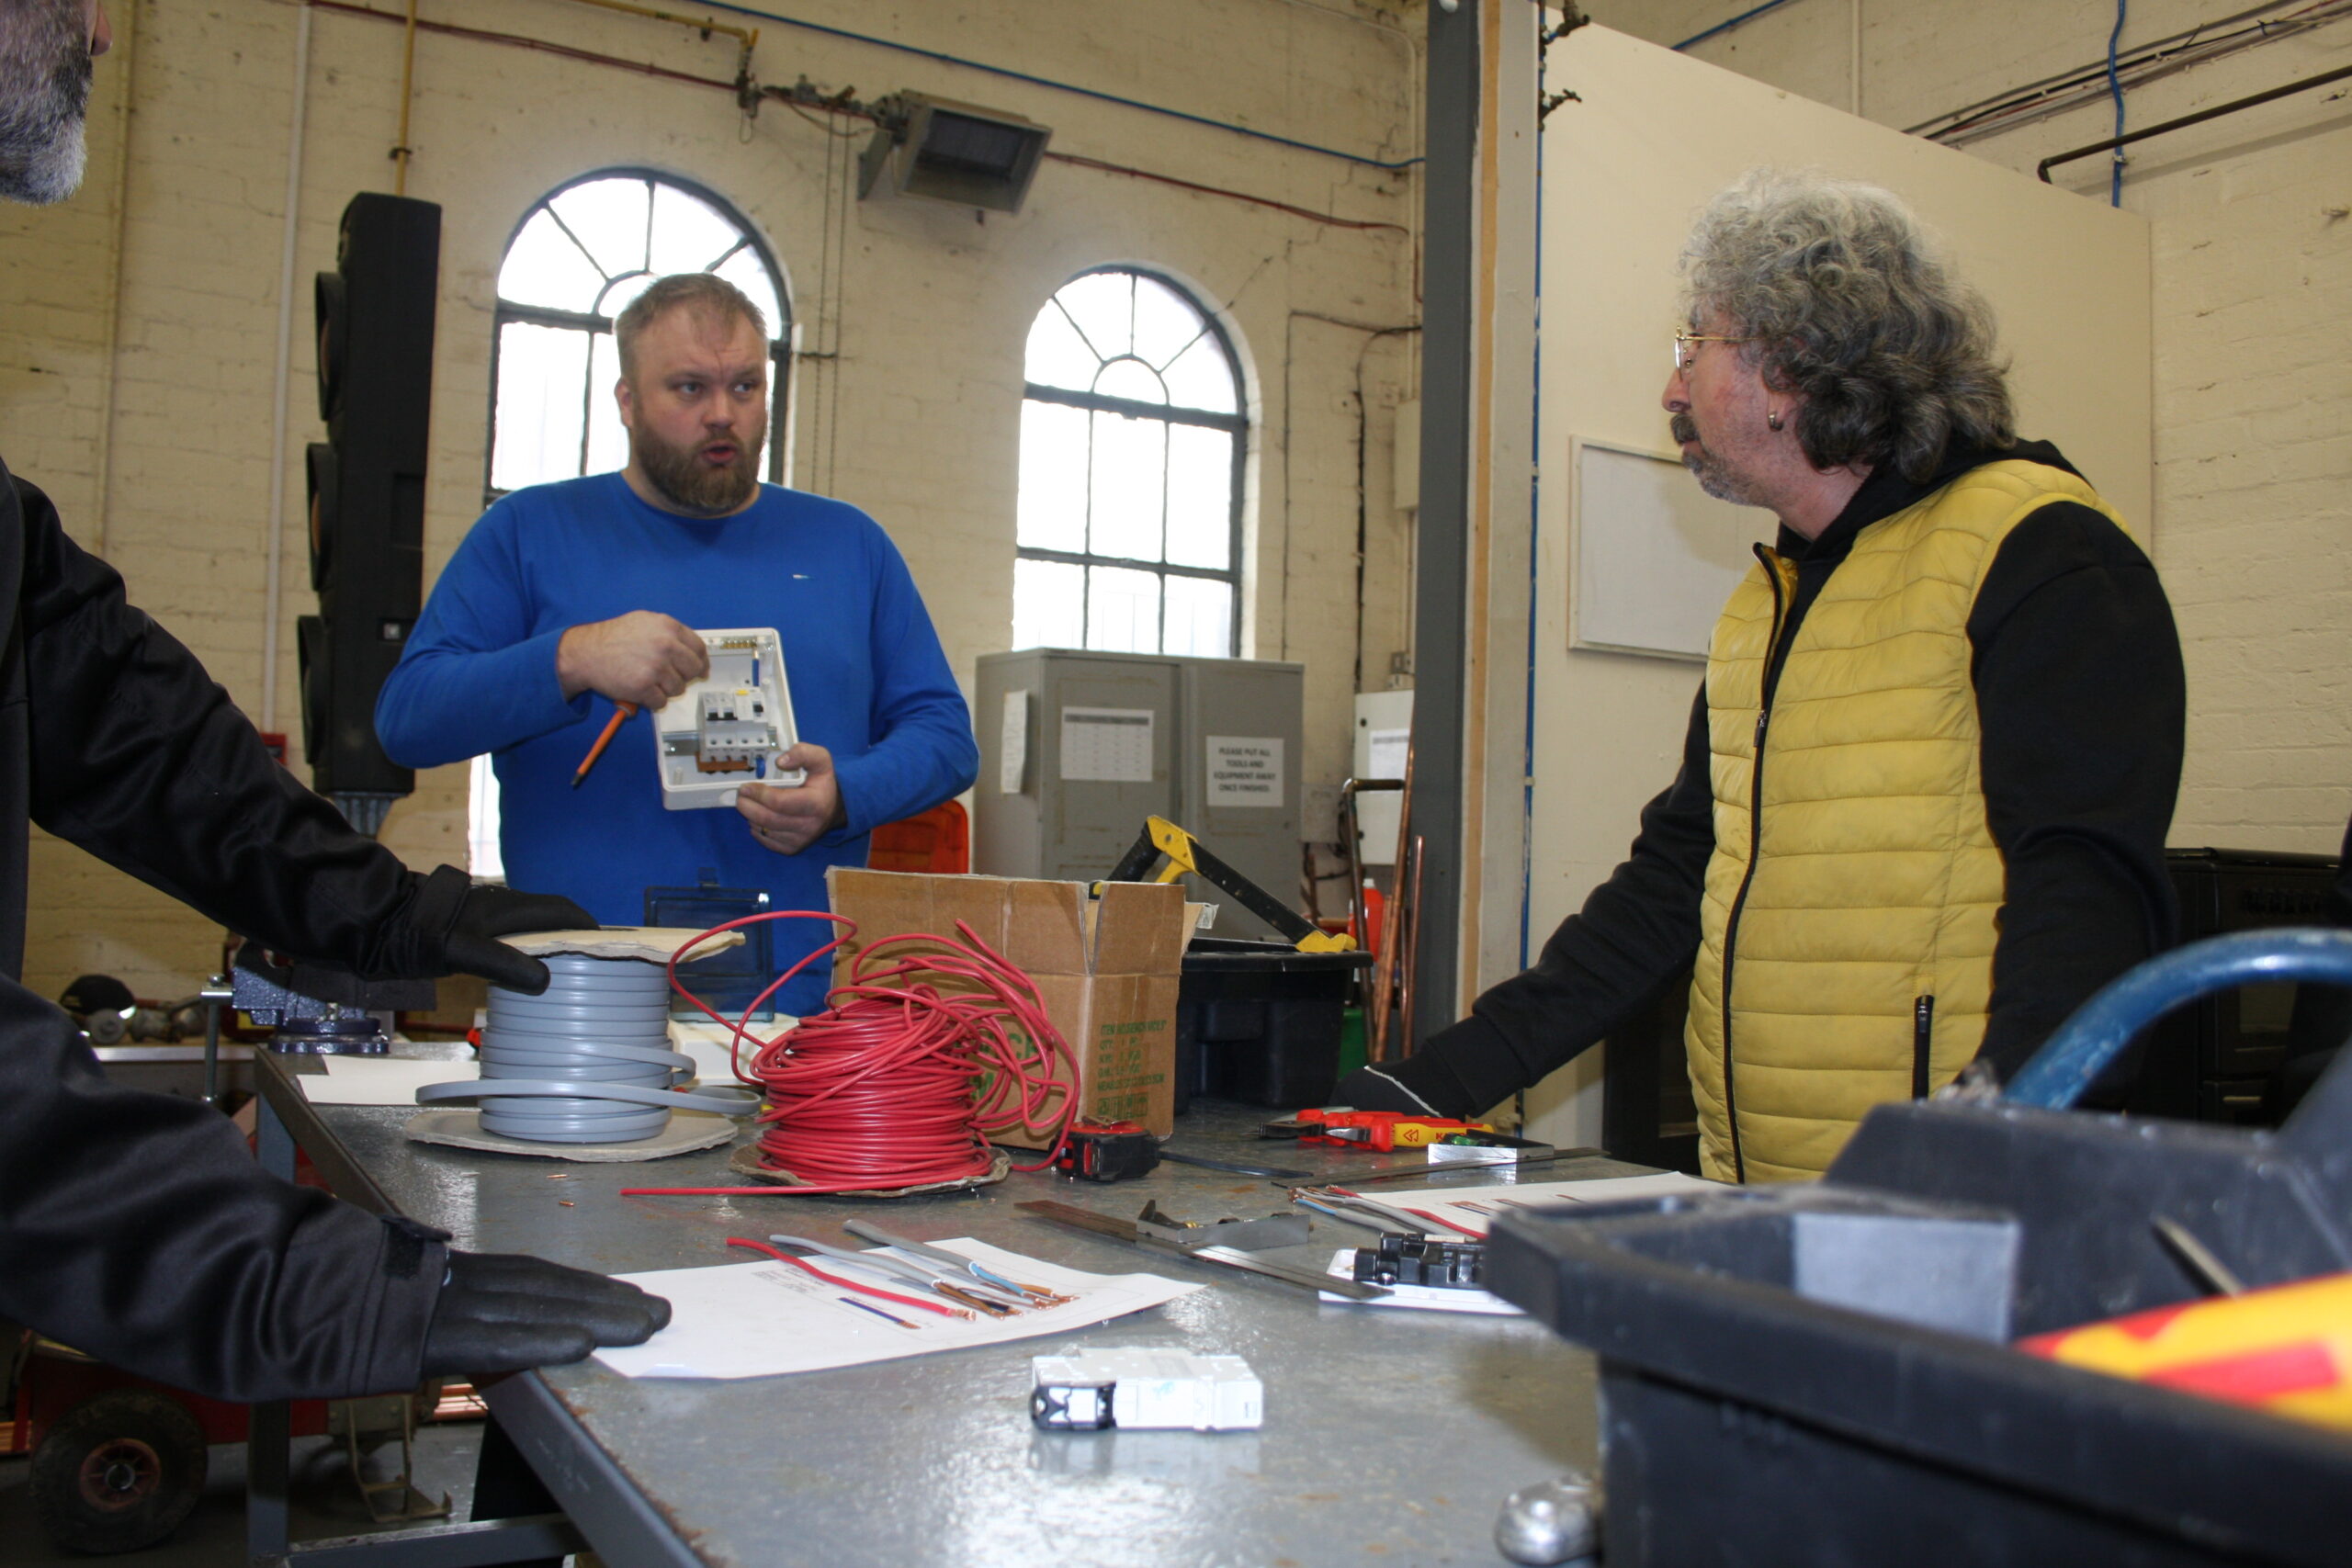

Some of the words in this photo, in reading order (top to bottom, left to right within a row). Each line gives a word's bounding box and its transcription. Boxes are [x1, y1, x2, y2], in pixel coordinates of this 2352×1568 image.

[1218, 747, 1242, 756] PLEASE
[1244, 748, 1257, 756] PUT
[1259, 749, 1271, 757] ALL
[1226, 759, 1248, 768] TOOLS
[1249, 760, 1264, 769] AND
[1214, 771, 1254, 780] EQUIPMENT
[1255, 772, 1276, 781] AWAY
[1218, 783, 1237, 793] ONCE
